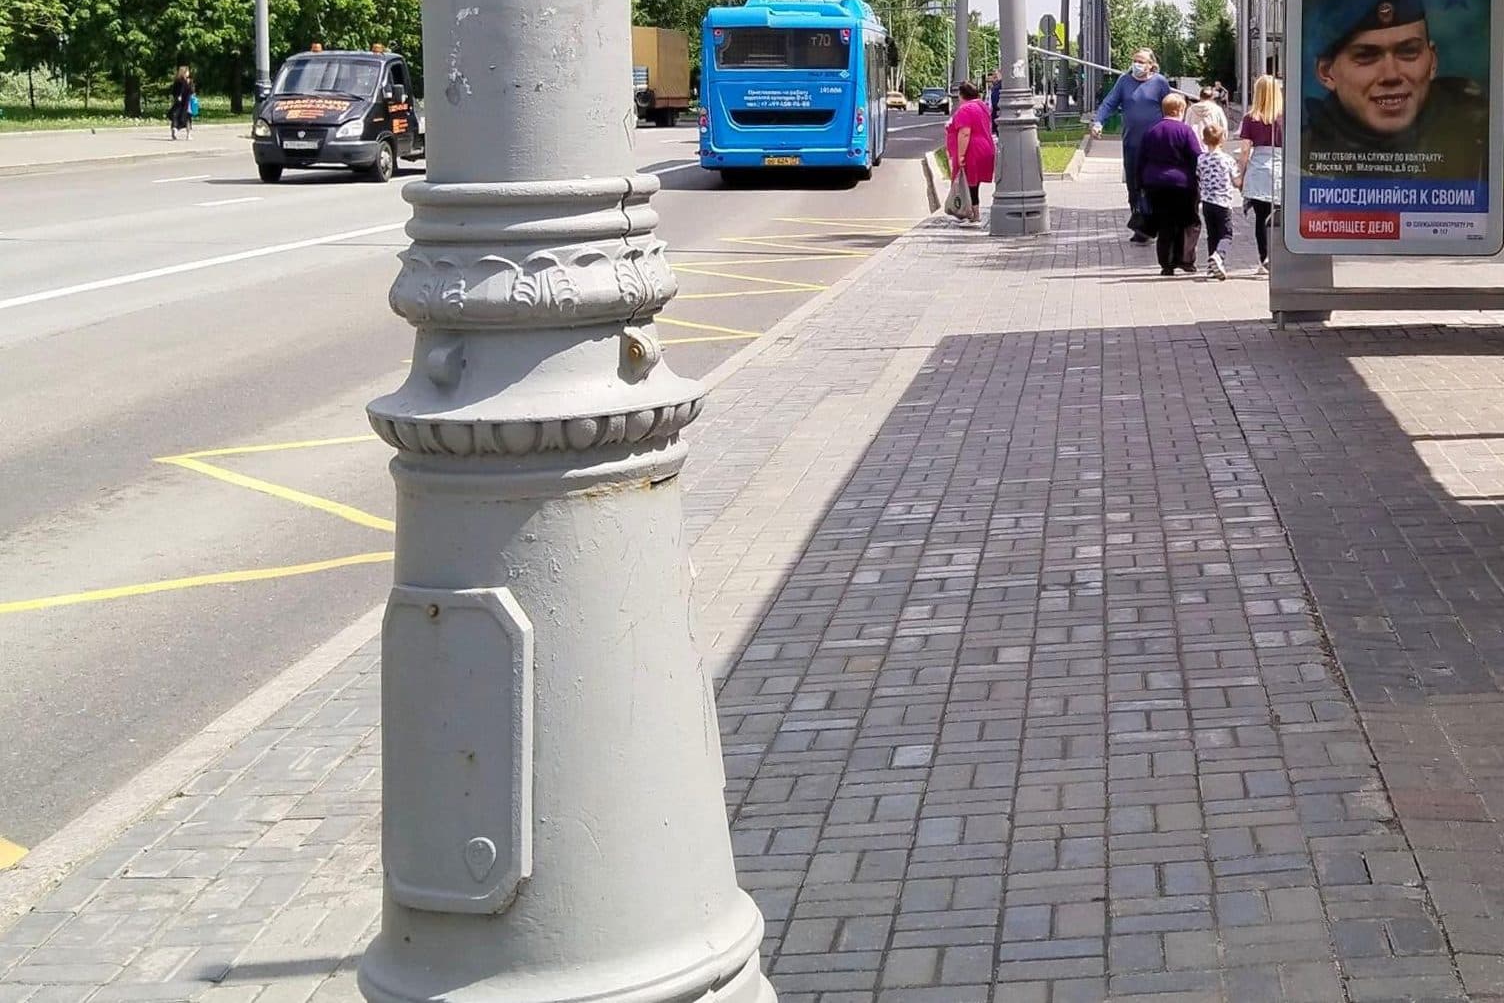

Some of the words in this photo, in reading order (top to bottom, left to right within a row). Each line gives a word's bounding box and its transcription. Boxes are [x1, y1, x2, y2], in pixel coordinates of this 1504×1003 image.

[1309, 186, 1417, 206] ПРИСОЕДИНЯЙСЯ
[1420, 189, 1428, 205] К
[1431, 189, 1475, 205] СВОИМ
[1308, 220, 1365, 234] НАСТОЯЩЕЕ
[1367, 220, 1394, 234] ДЕЛО
